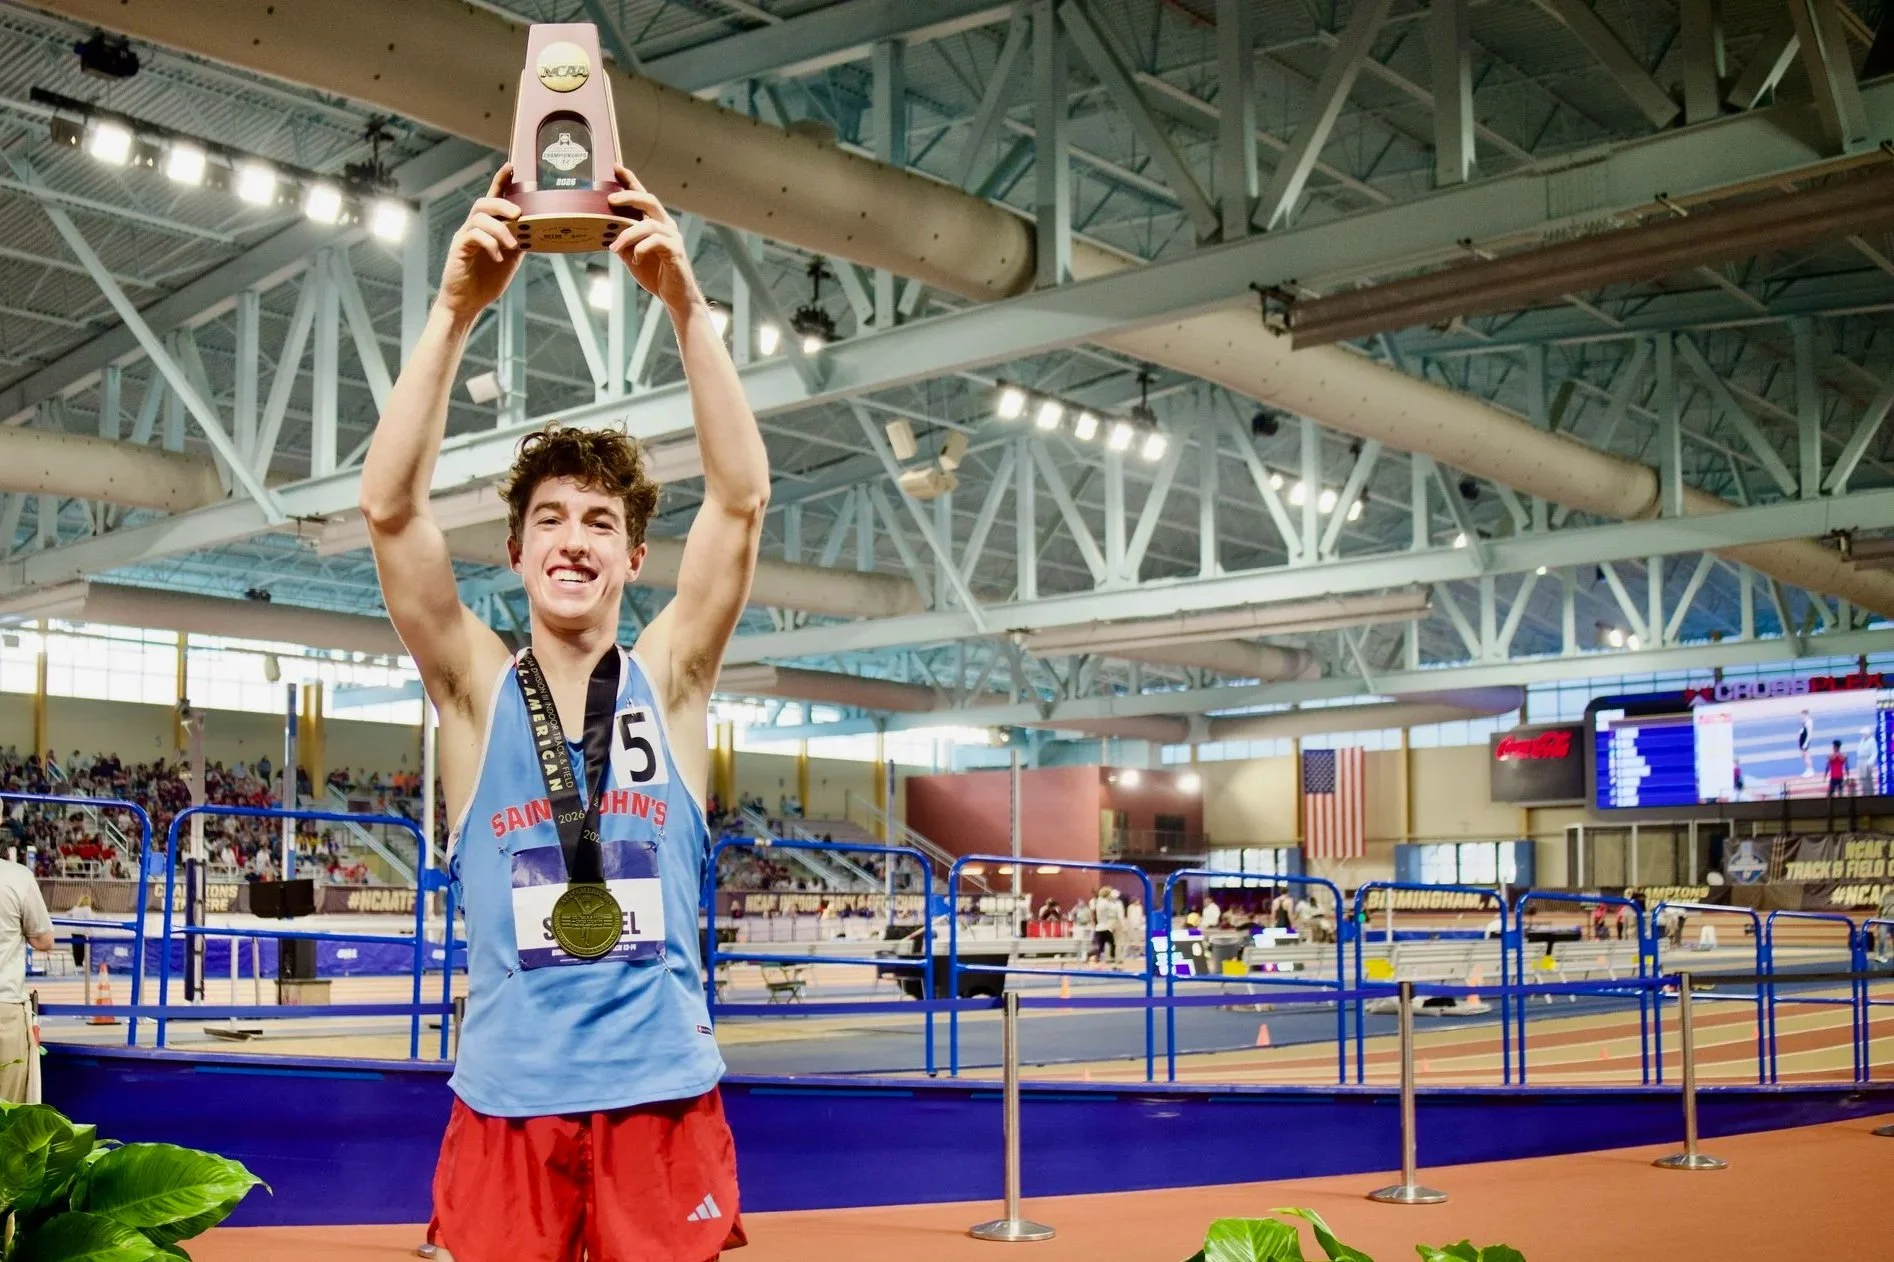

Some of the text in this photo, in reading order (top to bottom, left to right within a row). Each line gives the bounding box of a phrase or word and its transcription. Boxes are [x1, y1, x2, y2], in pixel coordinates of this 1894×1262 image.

[541, 64, 588, 77] NCAA
[556, 178, 576, 186] 2026
[518, 662, 564, 792] L-AMERICAN
[531, 668, 547, 694] DIVISION
[544, 701, 559, 730] INDOOR
[553, 731, 566, 757] TRACK
[562, 766, 574, 788] FIELD
[616, 711, 657, 783] 5
[490, 790, 669, 839] SAIN OHN'S
[558, 810, 586, 824] 2026
[584, 829, 602, 844] 202
[1785, 861, 1832, 880] TRACK
[1846, 859, 1885, 879] FIELD
[1624, 885, 1710, 898] CAMPIONS
